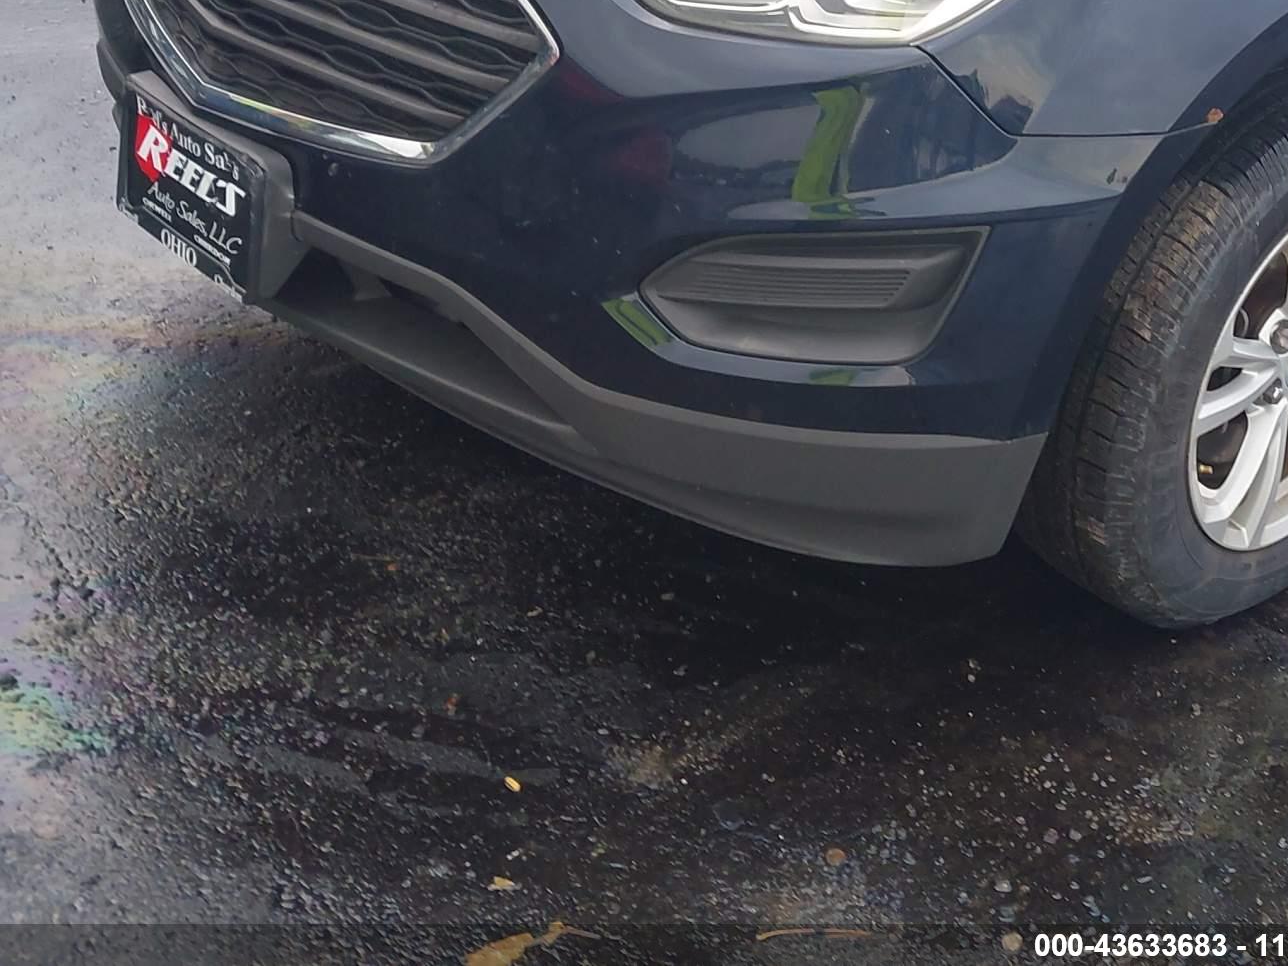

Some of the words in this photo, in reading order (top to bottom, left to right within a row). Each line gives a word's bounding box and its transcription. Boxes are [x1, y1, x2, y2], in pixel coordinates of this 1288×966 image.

[171, 123, 201, 157] Auto
[147, 182, 175, 222] Auto
[208, 220, 243, 255] LLC
[160, 227, 197, 268] OHIO
